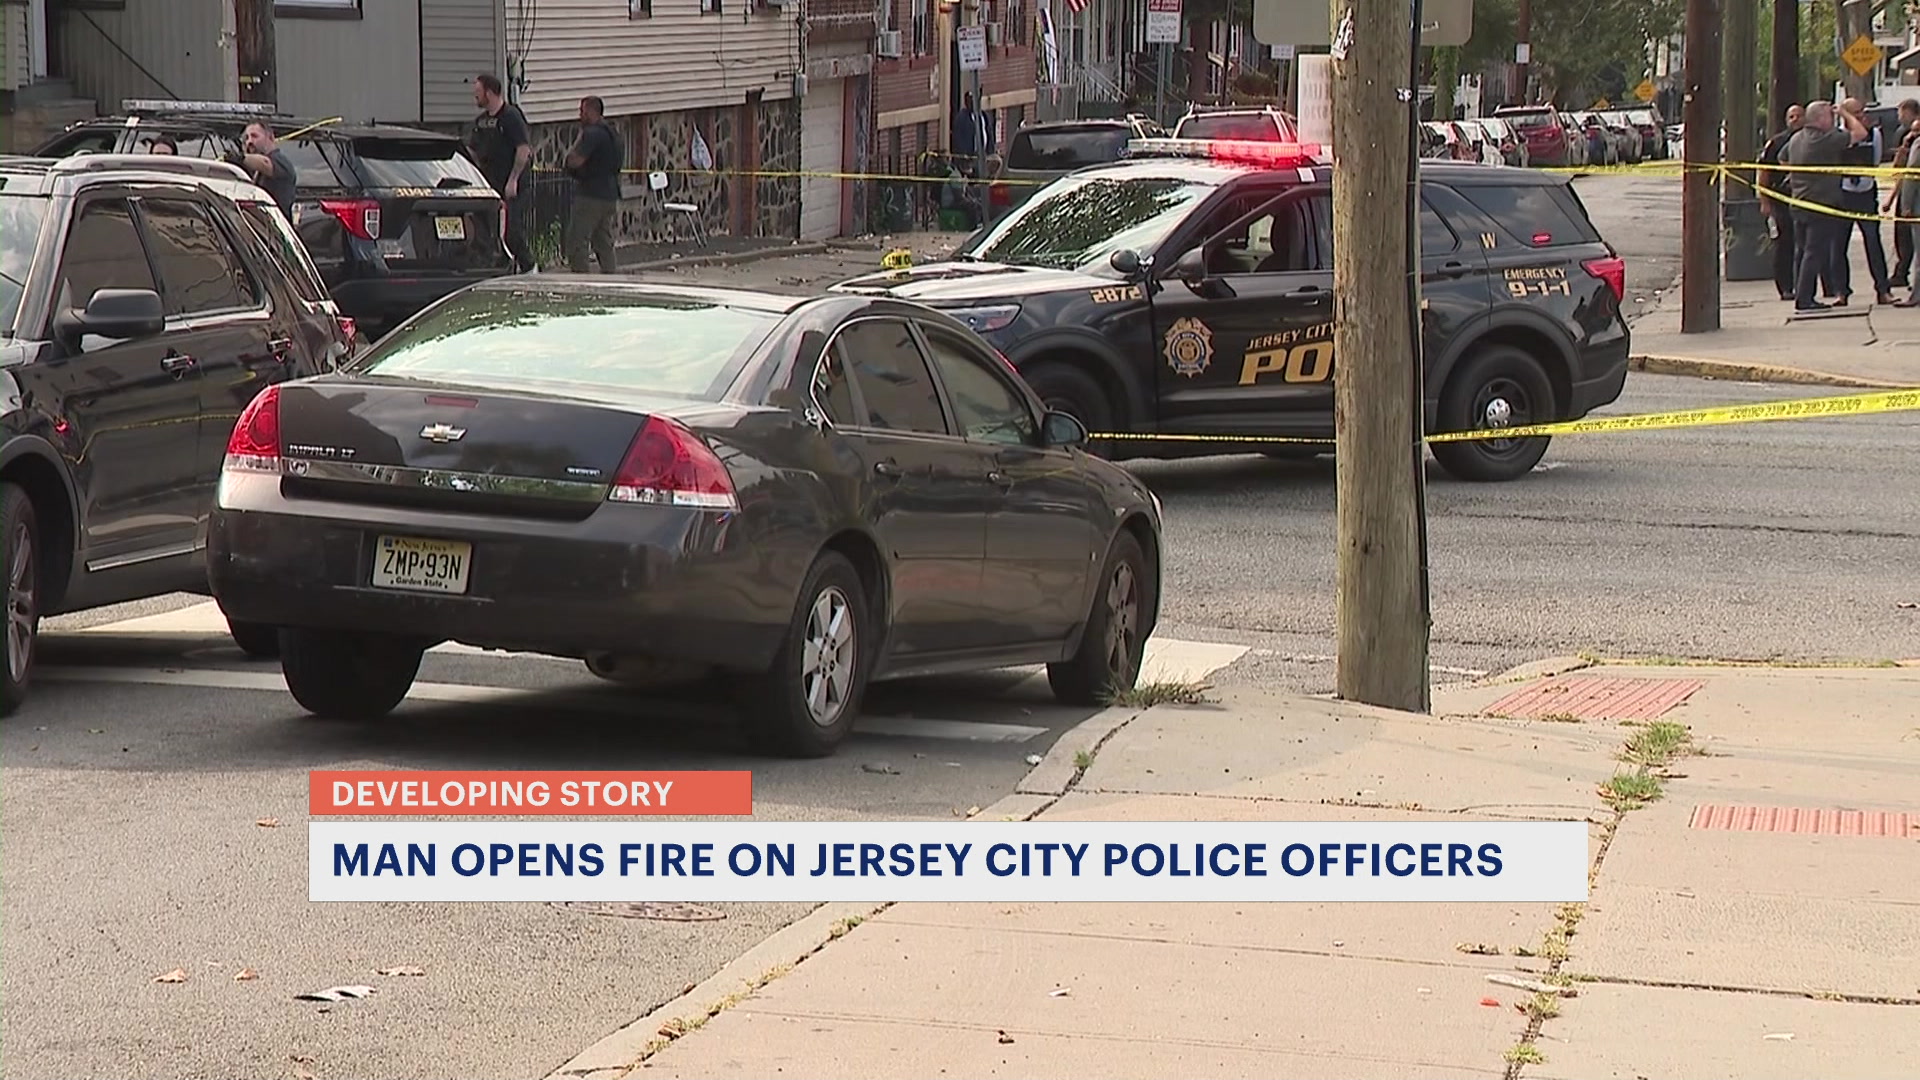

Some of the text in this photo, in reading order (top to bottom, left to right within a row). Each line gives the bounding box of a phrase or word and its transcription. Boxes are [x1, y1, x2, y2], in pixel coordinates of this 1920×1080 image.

[1481, 232, 1496, 249] W
[1504, 267, 1566, 280] EMERGENCY
[1090, 286, 1143, 304] 2872
[1508, 280, 1571, 297] 9-1-1
[1246, 320, 1338, 350] JERSEY CITY
[395, 577, 422, 585] Garden
